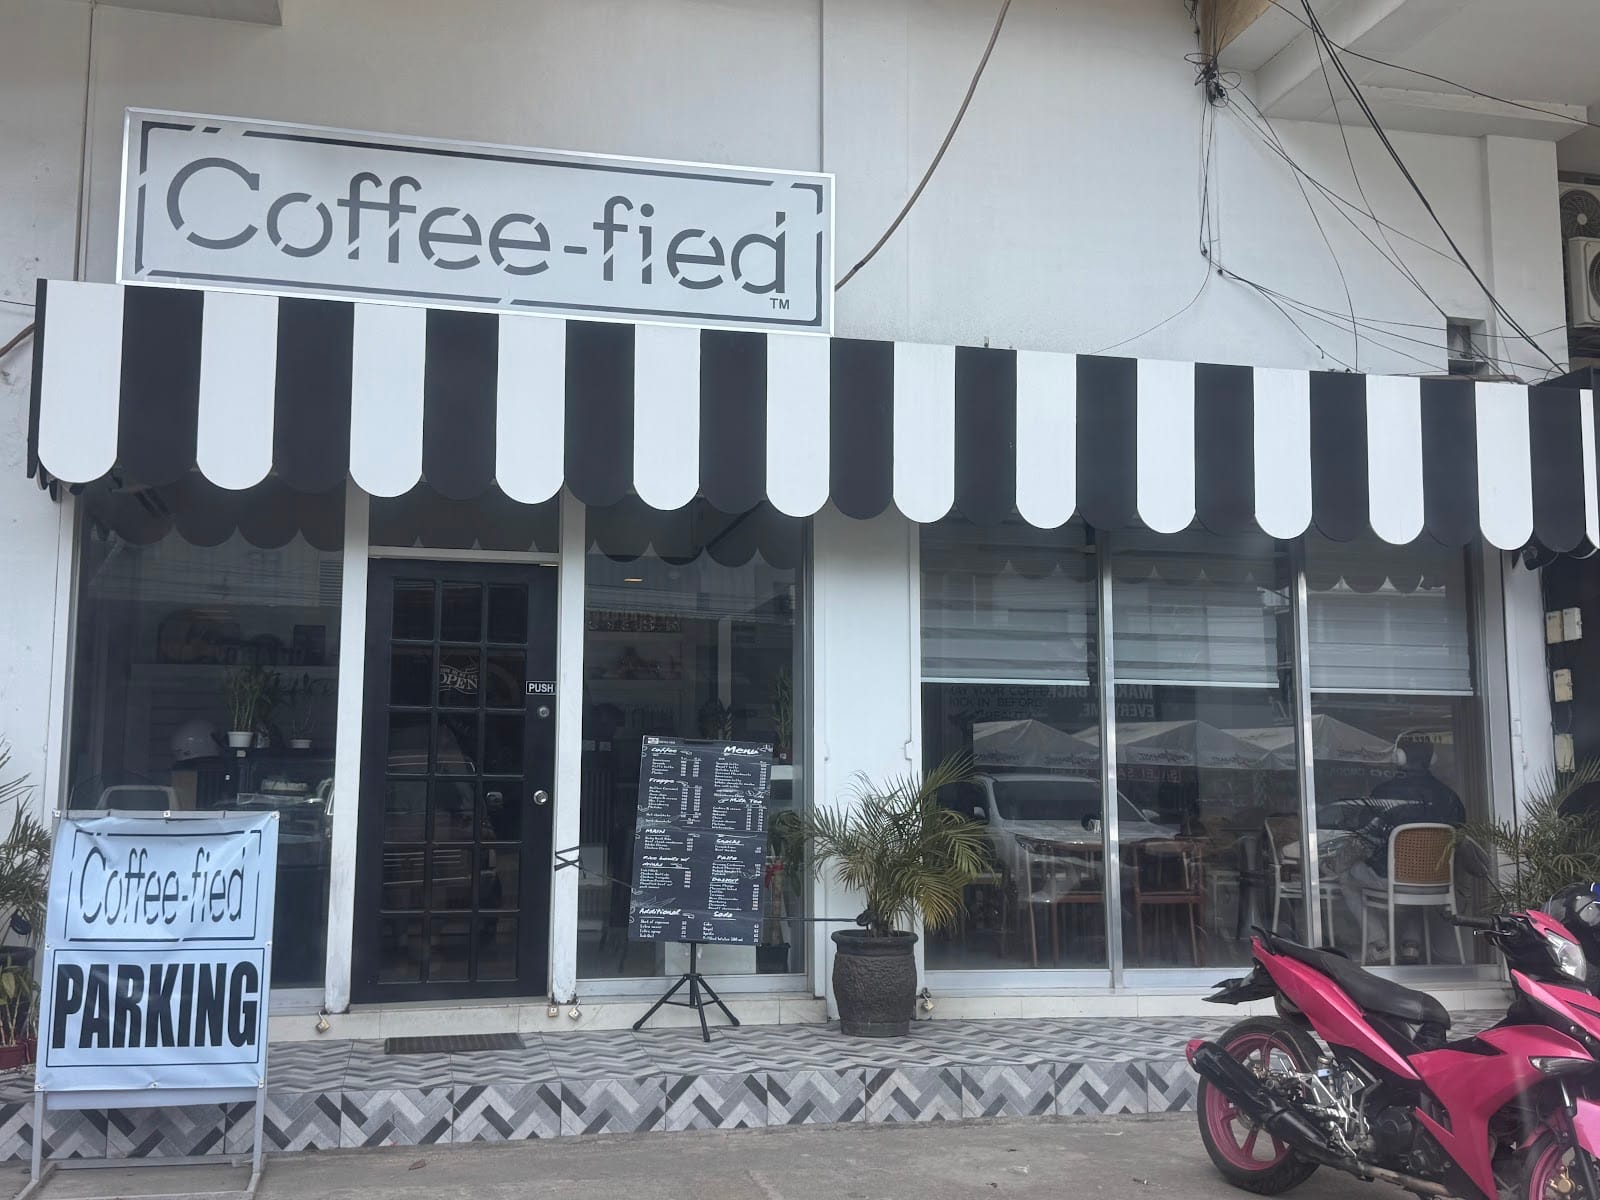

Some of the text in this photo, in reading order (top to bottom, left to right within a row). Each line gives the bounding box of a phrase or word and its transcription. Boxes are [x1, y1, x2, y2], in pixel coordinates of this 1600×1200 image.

[166, 156, 786, 295] Coffee-fied
[769, 297, 790, 310] TM
[528, 683, 554, 693] PUSH
[723, 745, 759, 755] Menu
[79, 845, 246, 926] Coffee-fied
[639, 907, 682, 915] Additional
[52, 960, 259, 1049] PARKING
